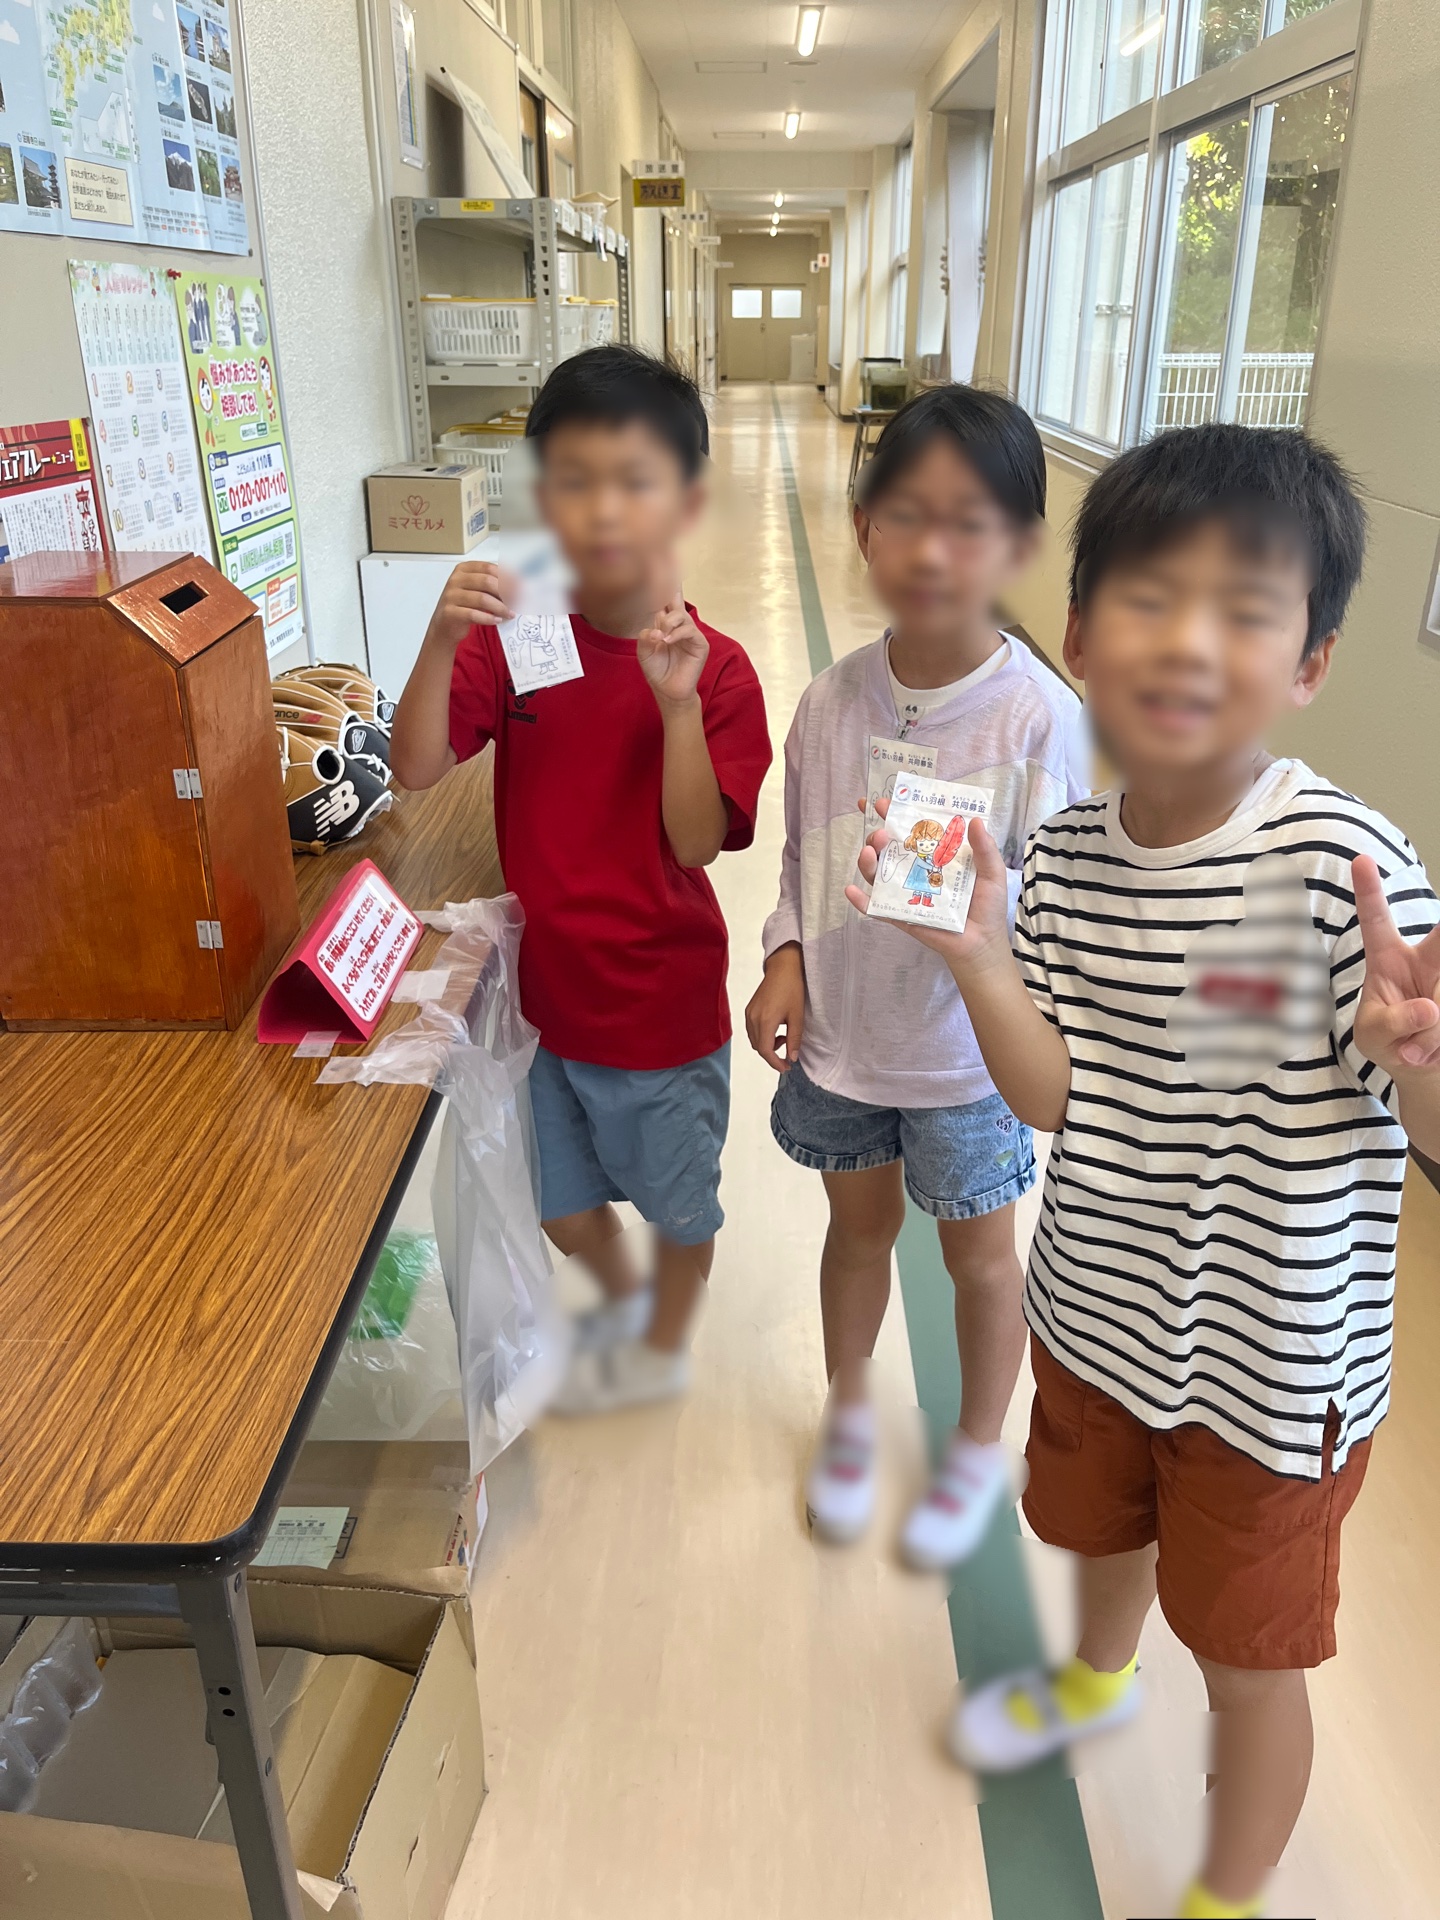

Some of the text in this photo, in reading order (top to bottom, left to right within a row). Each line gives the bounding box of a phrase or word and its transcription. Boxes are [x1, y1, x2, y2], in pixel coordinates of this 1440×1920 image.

[91, 373, 99, 397] 1
[126, 371, 134, 393] 2
[210, 361, 257, 386] 悩みがあったら
[221, 392, 258, 417] 相談してね!
[132, 414, 139, 437] 5
[0, 449, 50, 481] ェアプレー
[106, 452, 174, 487] 7 8 9
[229, 472, 287, 511] 0120-007-110
[113, 508, 124, 532] 10
[388, 517, 445, 531] ミマモルメ
[882, 753, 933, 768] 赤い羽根 共同募金
[912, 793, 987, 813] 赤い羽根 共同募金
[949, 871, 962, 909] あかはねちゃん
